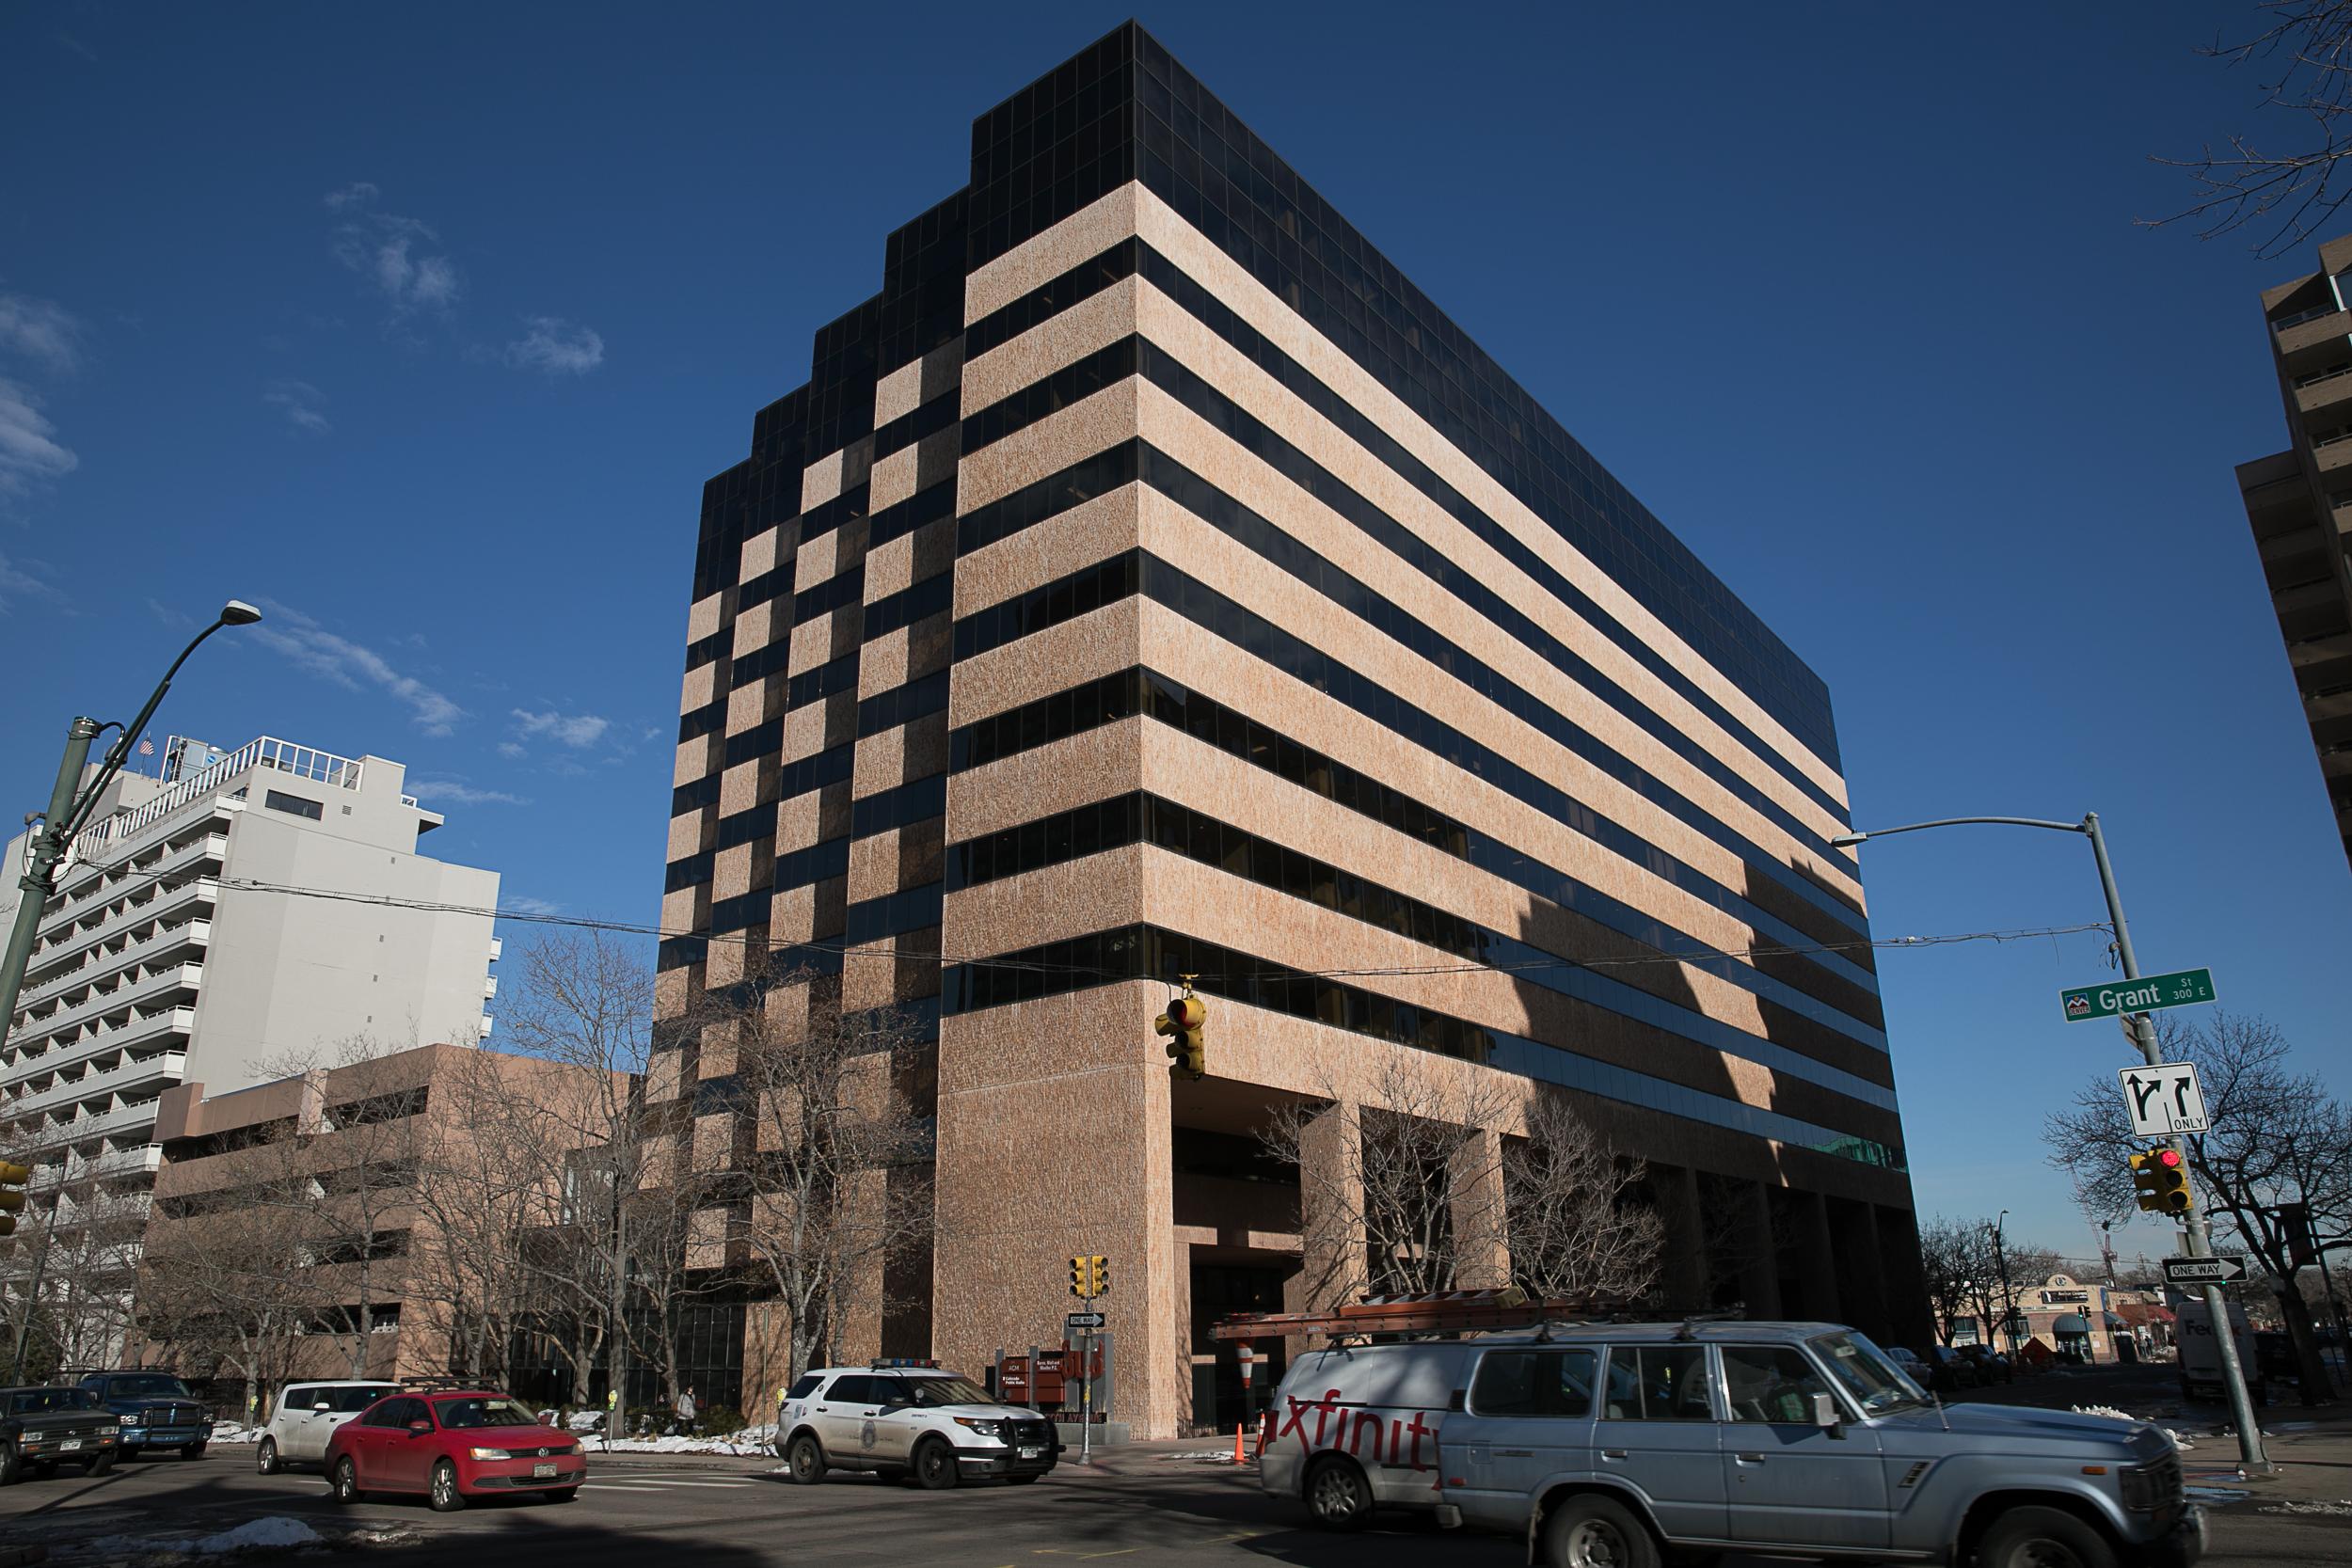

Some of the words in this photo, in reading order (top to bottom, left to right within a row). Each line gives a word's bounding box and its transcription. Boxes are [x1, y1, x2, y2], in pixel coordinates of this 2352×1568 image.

[2181, 978, 2193, 988] St
[2099, 983, 2161, 1010] Grant
[2173, 989, 2193, 1000] 300
[2199, 987, 2206, 996] E
[2174, 1117, 2203, 1130] ONLY
[2172, 1265, 2195, 1276] ONE
[2197, 1264, 2220, 1275] WAY
[1279, 1389, 1442, 1491] xfinit
